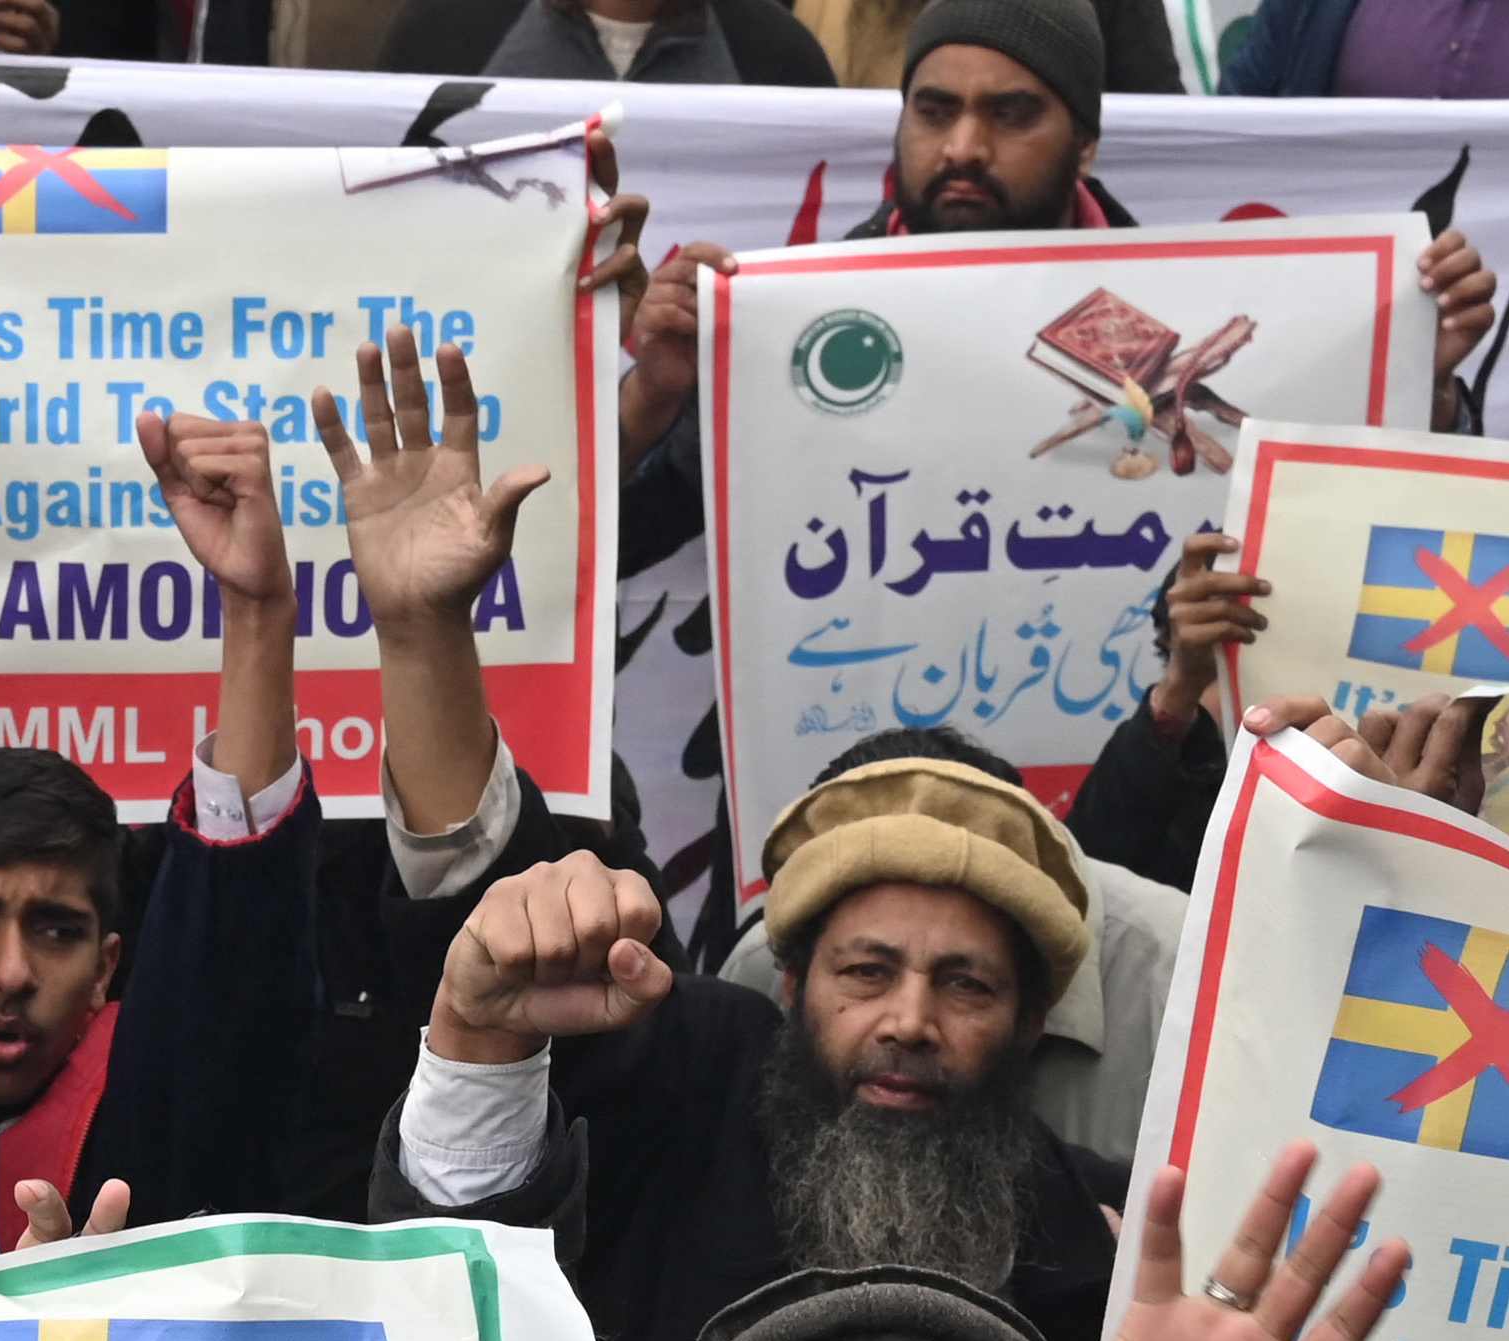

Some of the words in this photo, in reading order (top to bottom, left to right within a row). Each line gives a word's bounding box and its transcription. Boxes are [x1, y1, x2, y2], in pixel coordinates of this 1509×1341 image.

[48, 296, 205, 362] Time
[232, 296, 335, 361] For
[358, 296, 475, 359] The
[783, 468, 992, 600] قرآن
[786, 616, 919, 694] ہے
